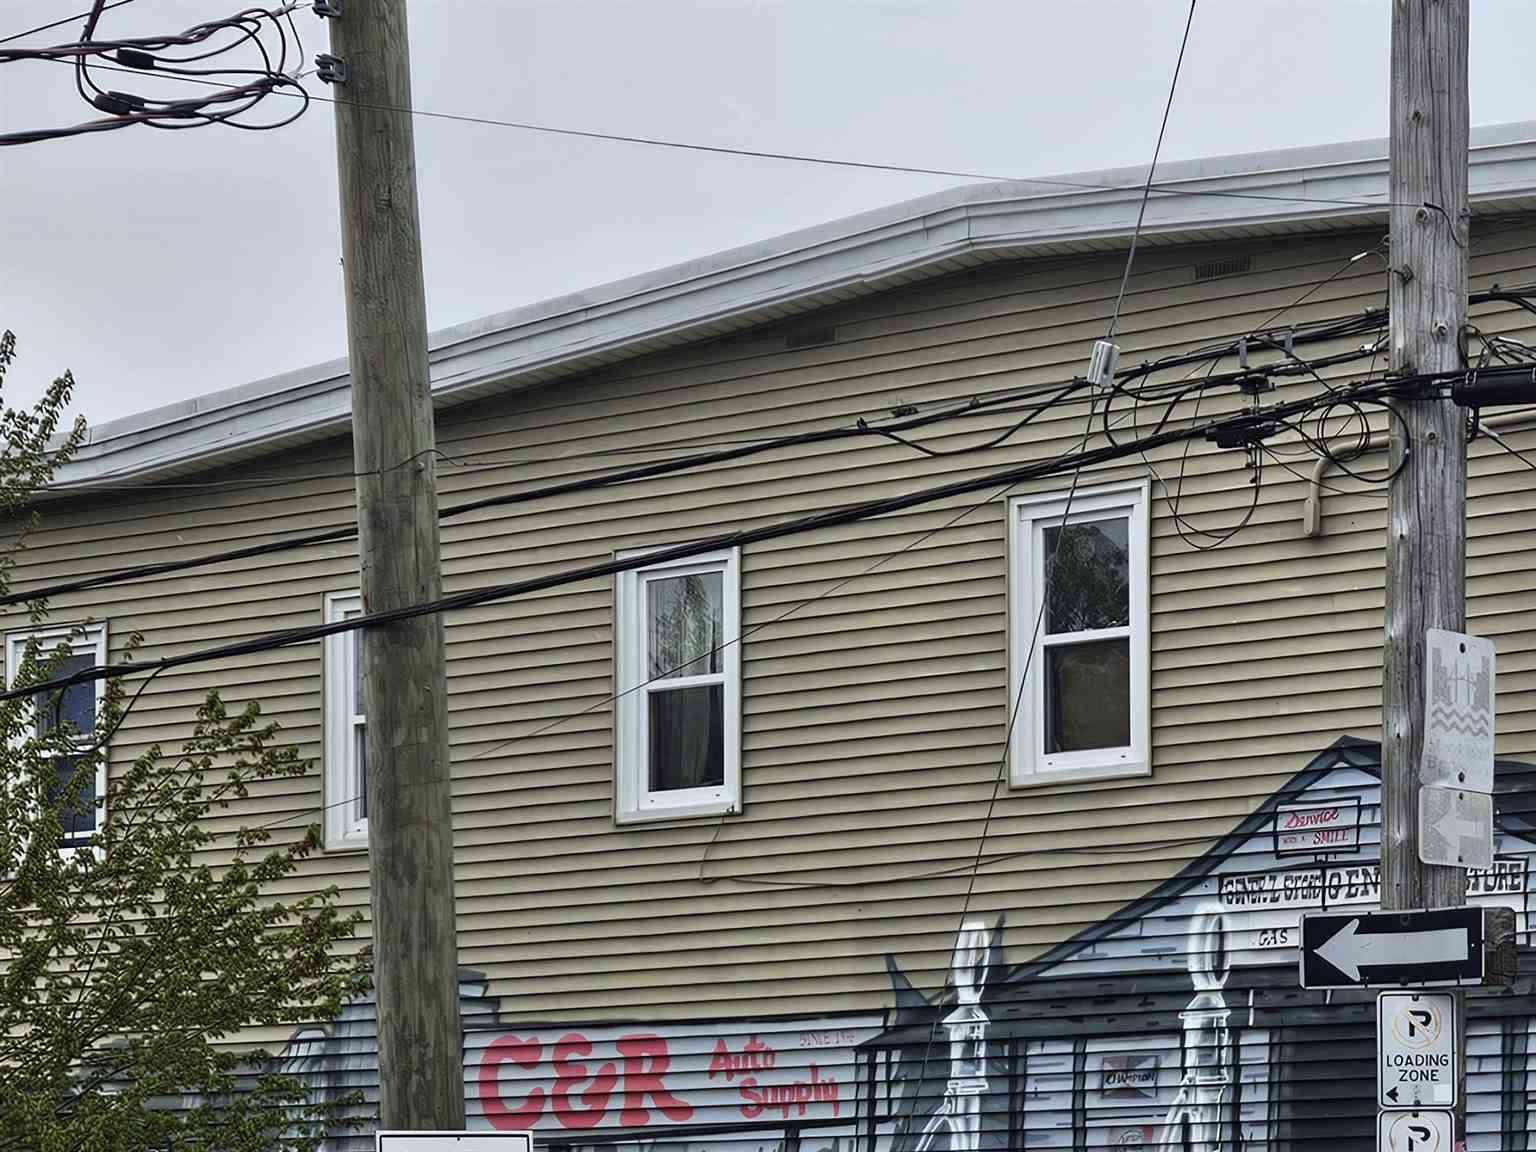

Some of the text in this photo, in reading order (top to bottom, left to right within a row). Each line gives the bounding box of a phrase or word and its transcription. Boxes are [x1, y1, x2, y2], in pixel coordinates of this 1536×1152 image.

[1259, 928, 1288, 946] GAS
[1386, 1054, 1448, 1068] LOADING
[478, 1032, 776, 1131] C&R Auto
[1399, 1070, 1439, 1082] ZONE
[739, 1062, 839, 1119] Supply
